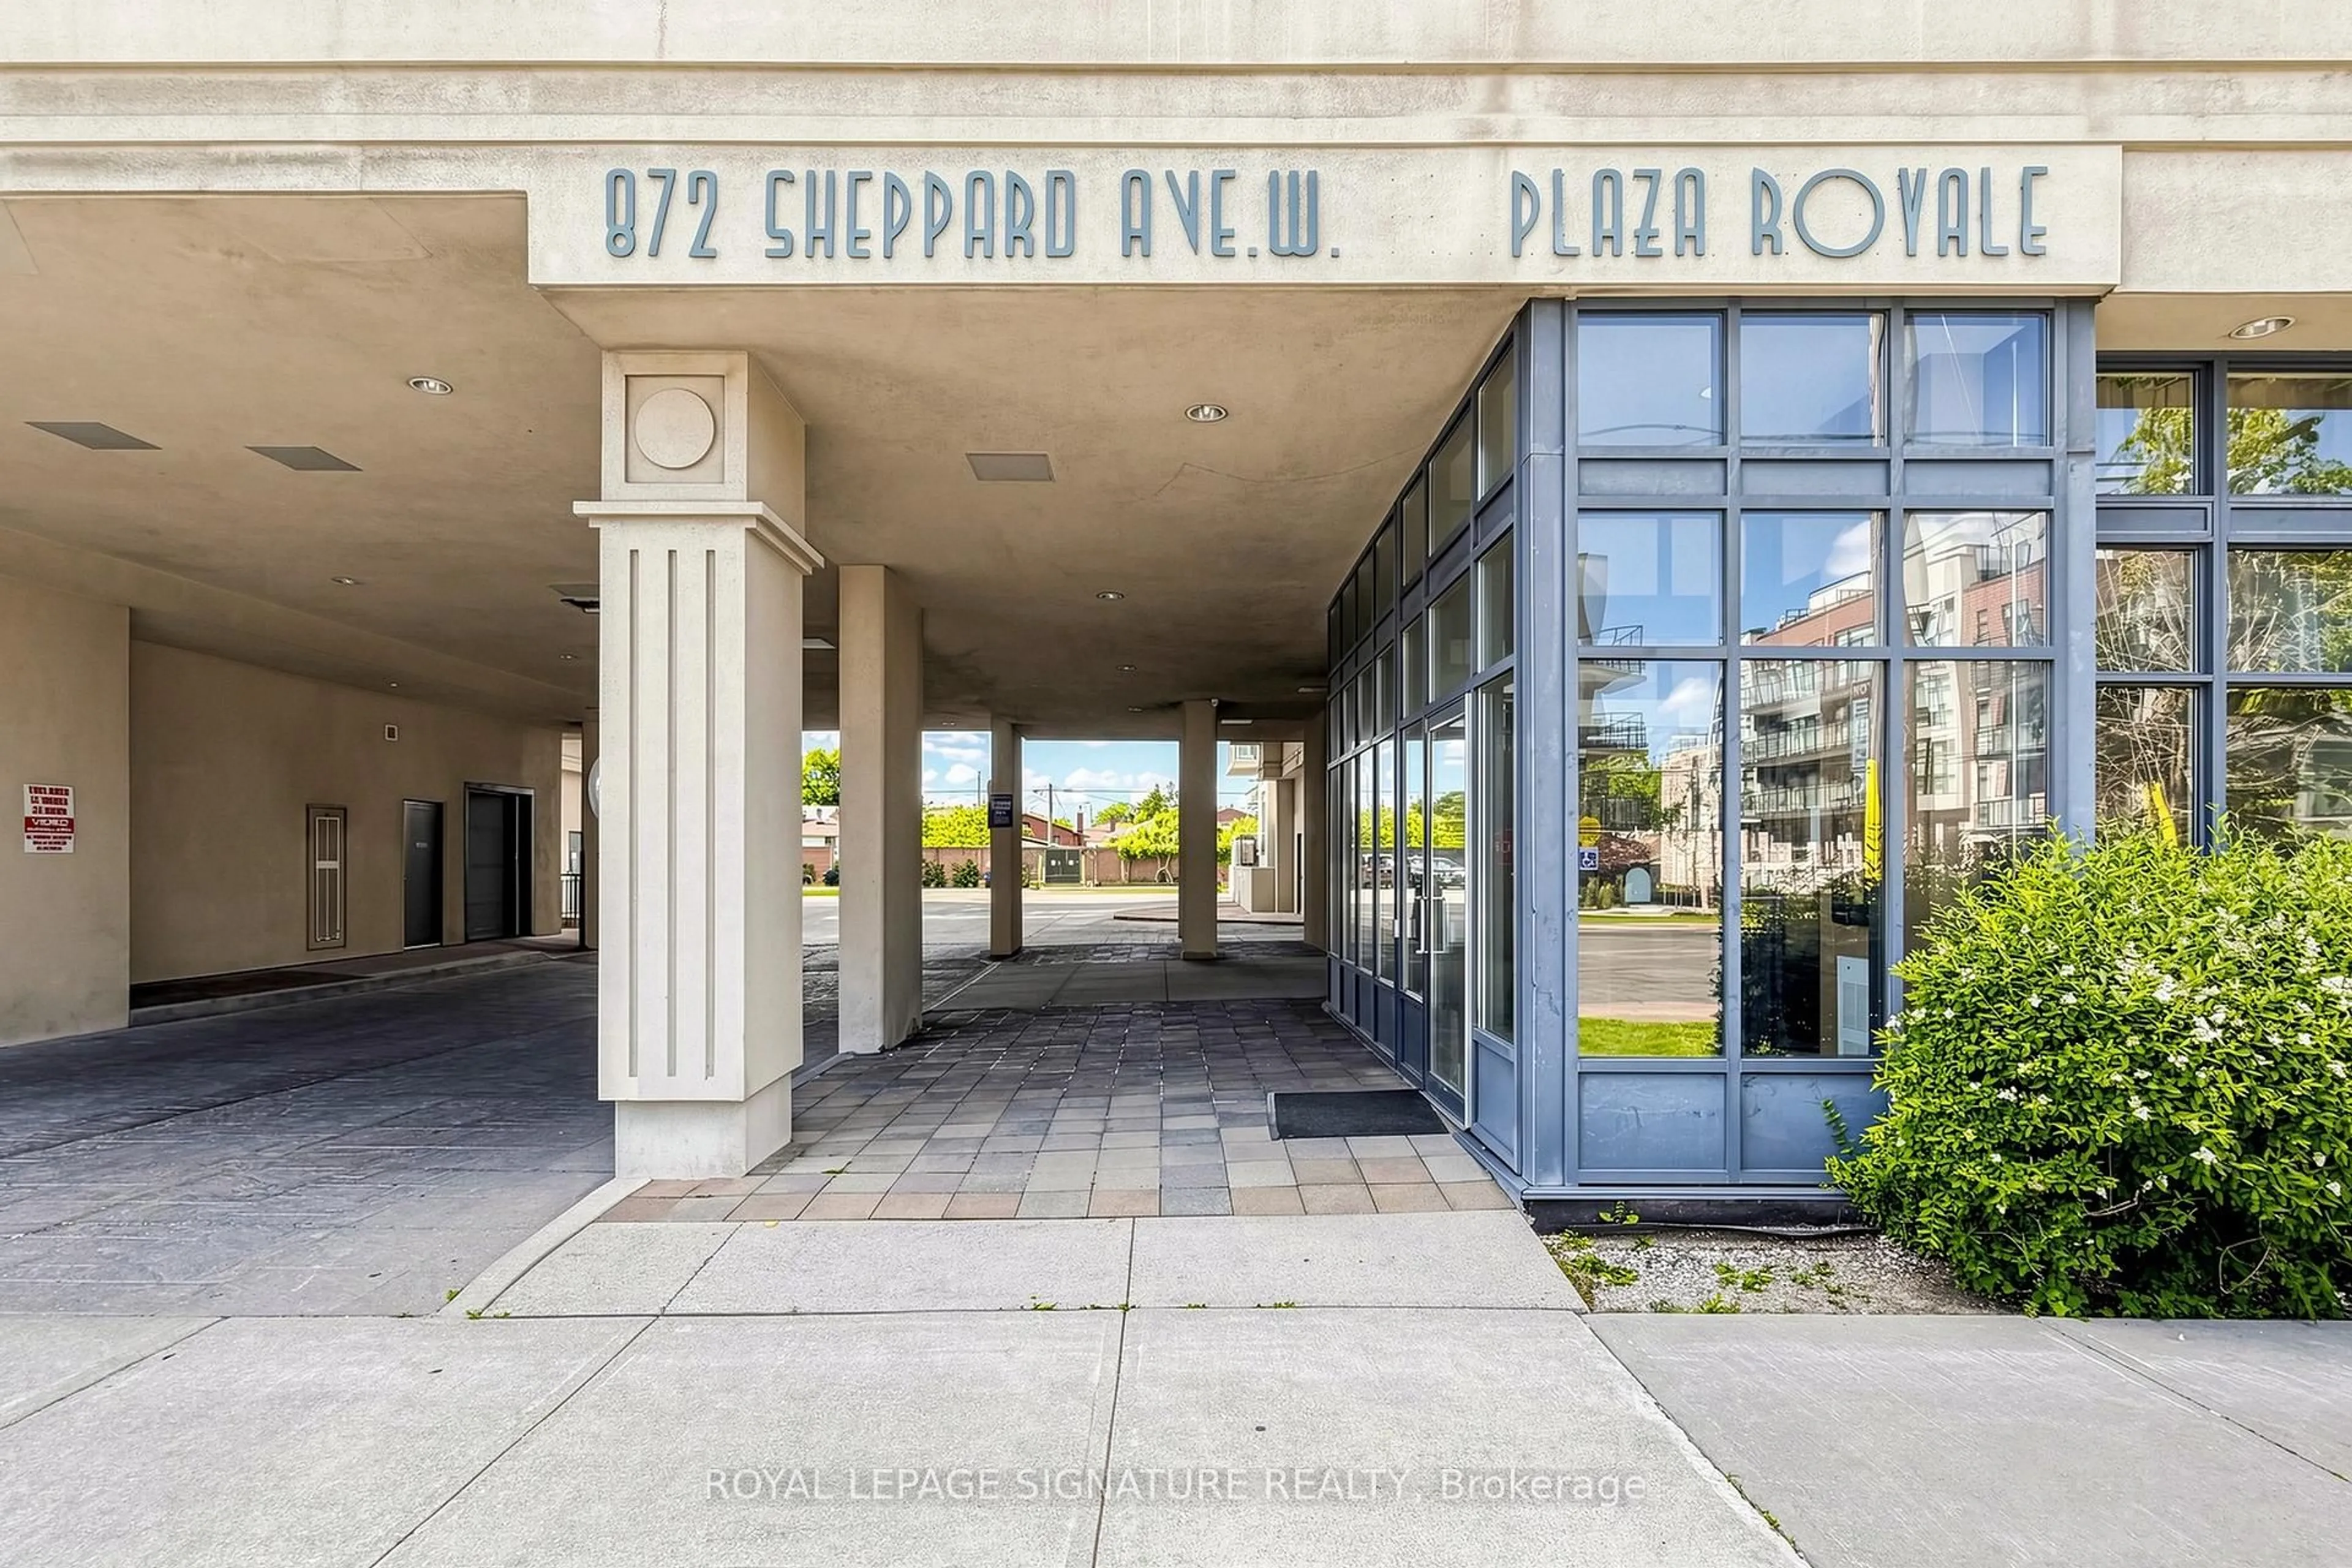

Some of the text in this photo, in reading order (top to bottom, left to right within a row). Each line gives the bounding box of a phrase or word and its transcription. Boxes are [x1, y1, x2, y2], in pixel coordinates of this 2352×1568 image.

[606, 168, 718, 258] 872
[765, 168, 1075, 258] SHEPPARD
[1512, 167, 2049, 258] PLAZA ROYALE
